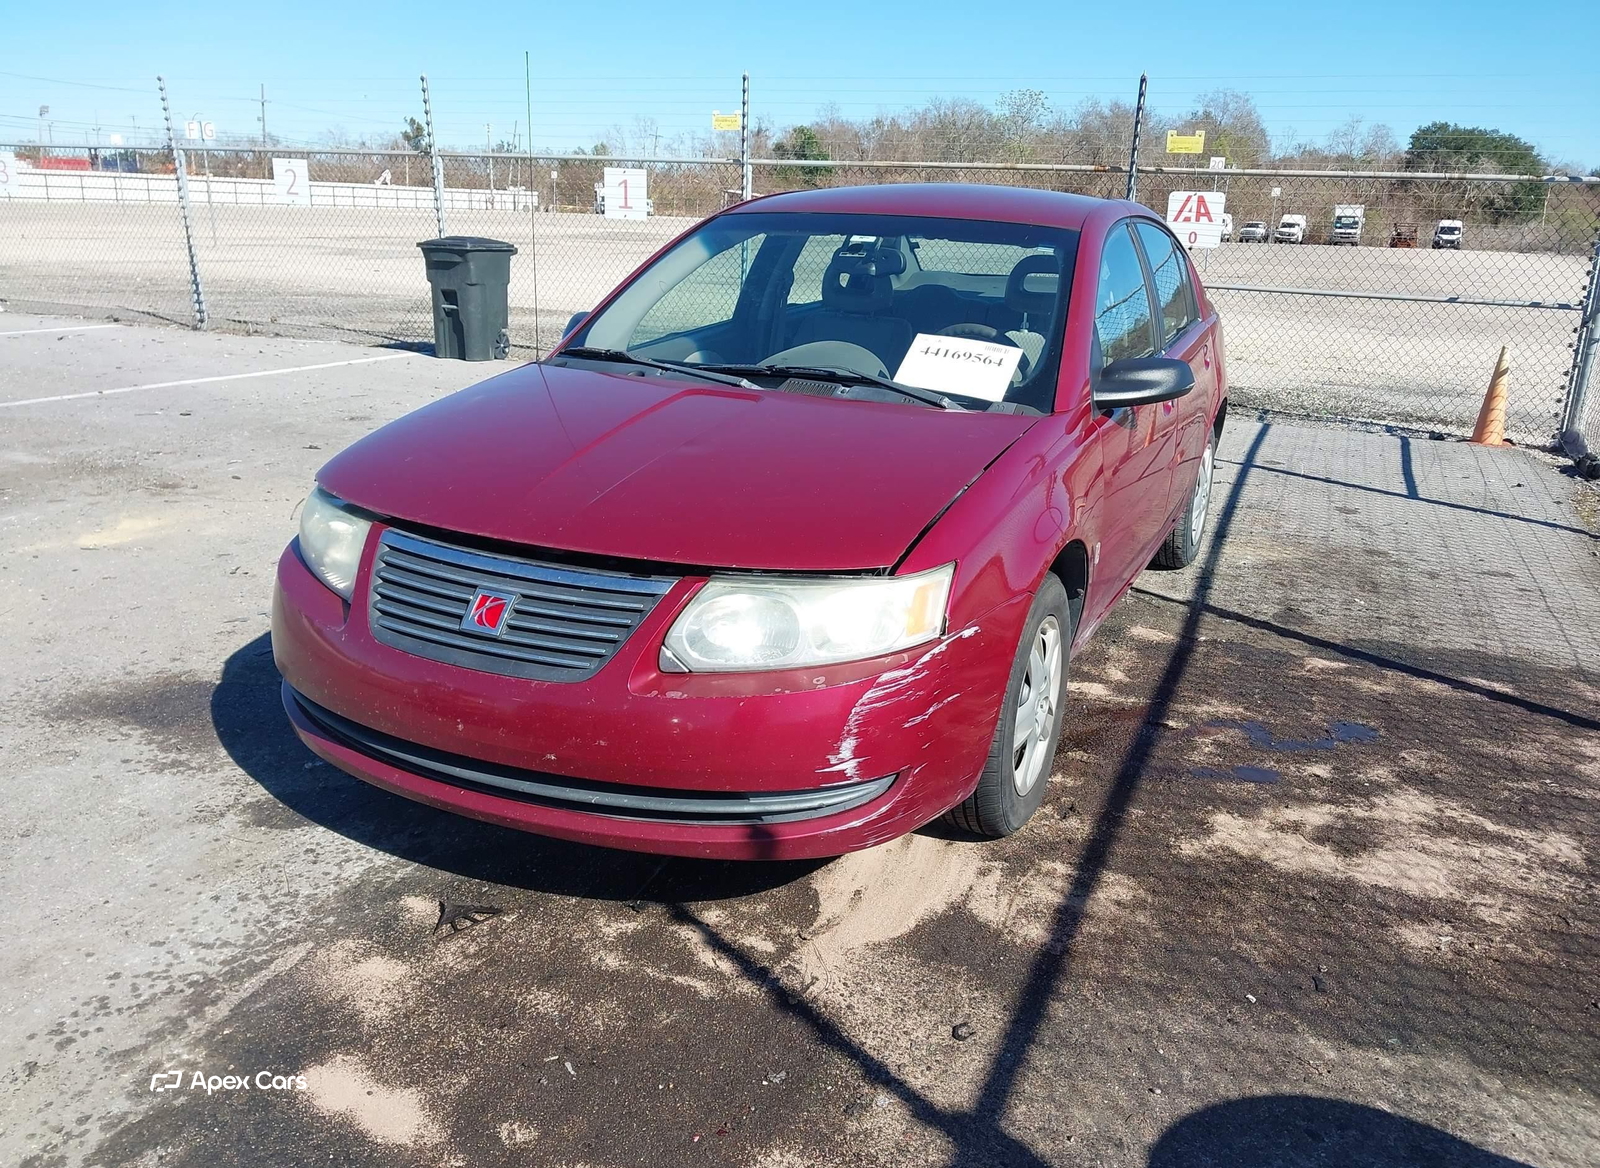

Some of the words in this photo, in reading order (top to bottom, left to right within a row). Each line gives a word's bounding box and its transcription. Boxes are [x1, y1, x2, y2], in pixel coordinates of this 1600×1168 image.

[187, 121, 195, 138] F
[203, 121, 214, 138] G
[284, 168, 299, 196] 2
[617, 178, 634, 210] 1
[920, 346, 1004, 367] 44169564
